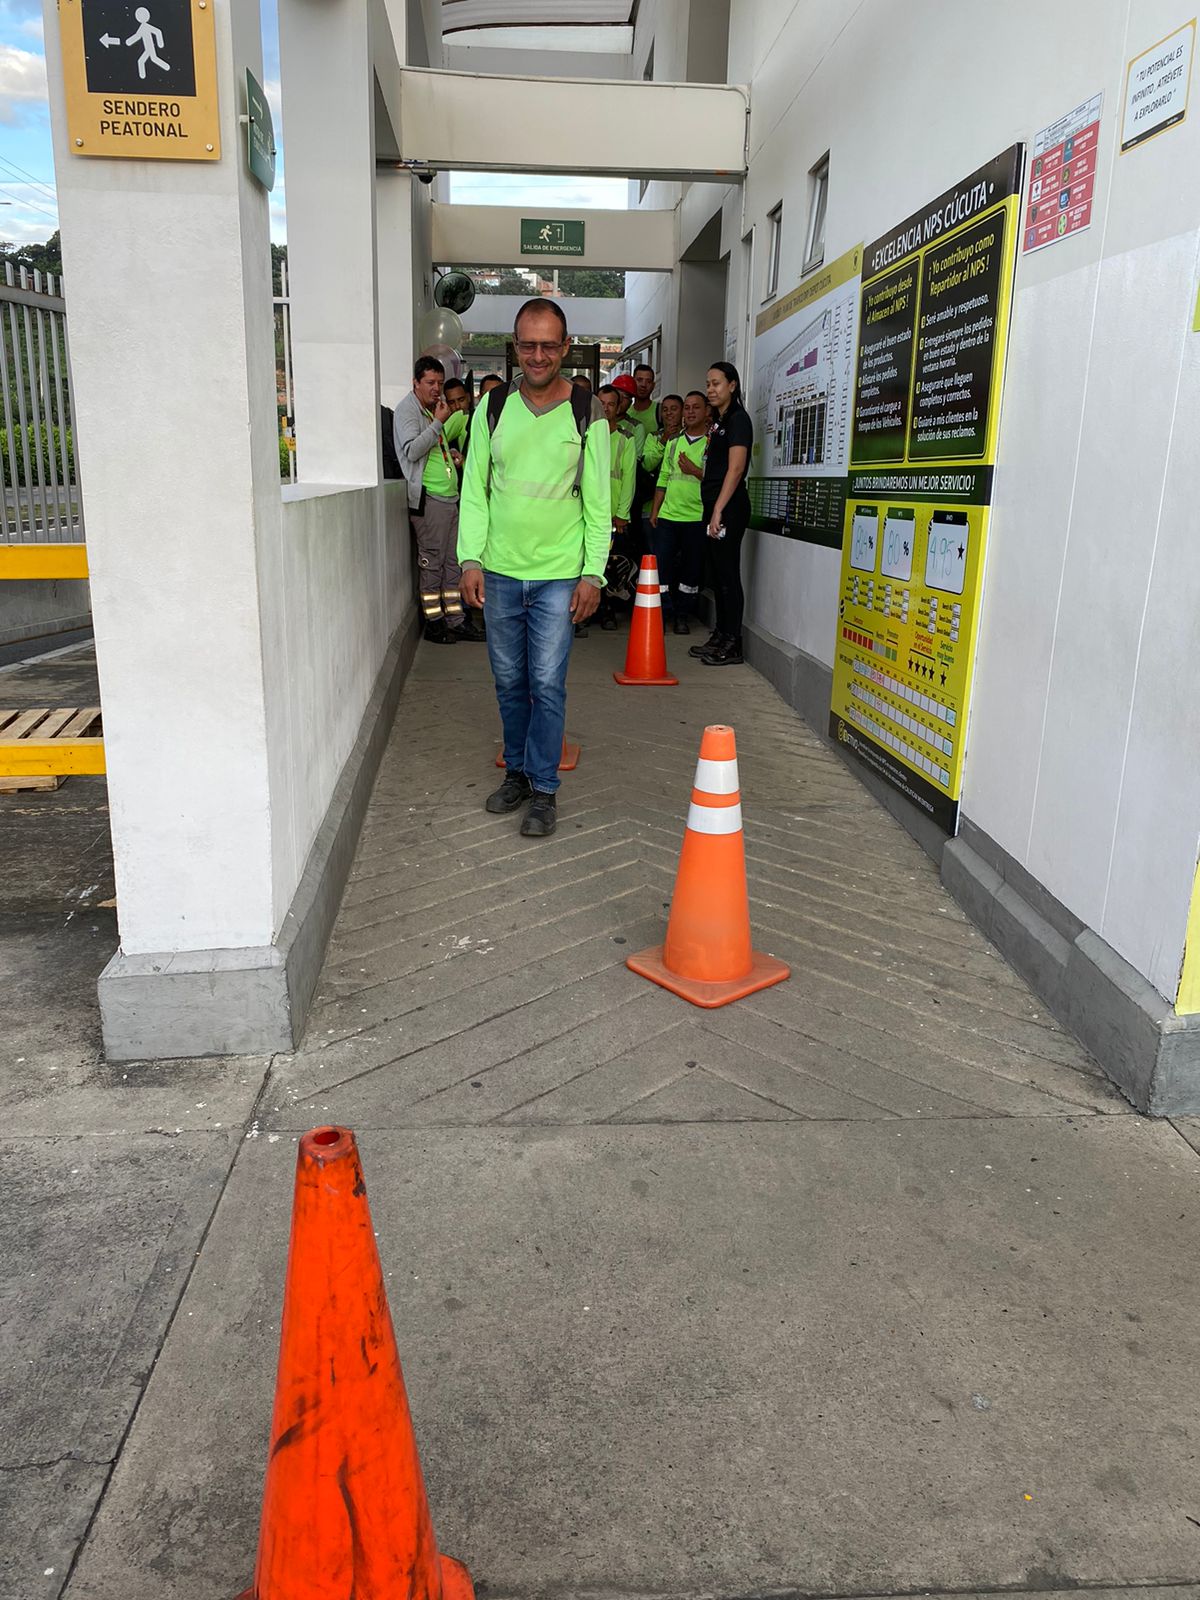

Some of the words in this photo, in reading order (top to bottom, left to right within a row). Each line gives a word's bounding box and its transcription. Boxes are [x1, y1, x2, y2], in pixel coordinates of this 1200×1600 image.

[103, 100, 181, 117] SENDERO
[100, 121, 188, 138] PEATONAL
[923, 209, 943, 241] NPS
[944, 180, 987, 228] CÚCUTA
[932, 259, 940, 275] Yo
[940, 244, 974, 271] contribuyo
[974, 233, 995, 253] como
[929, 270, 962, 297] Repartidor
[962, 263, 970, 282] al
[970, 256, 986, 278] NPS
[873, 285, 898, 306] contribuyo
[897, 273, 913, 293] desde
[925, 312, 937, 327] Seré
[936, 304, 954, 322] amable
[972, 315, 993, 335] pedidos
[940, 341, 956, 356] estado
[959, 336, 976, 350] dentro
[976, 332, 984, 345] de
[983, 330, 990, 343] la
[921, 377, 944, 394] Aseguraré
[943, 377, 954, 390] que
[919, 393, 943, 408] completos
[945, 411, 965, 422] clientes
[972, 407, 979, 420] la
[951, 424, 976, 438] reclamos.
[908, 475, 918, 490] UN
[918, 475, 940, 490] MEJOR
[940, 474, 972, 491] SERVICIO
